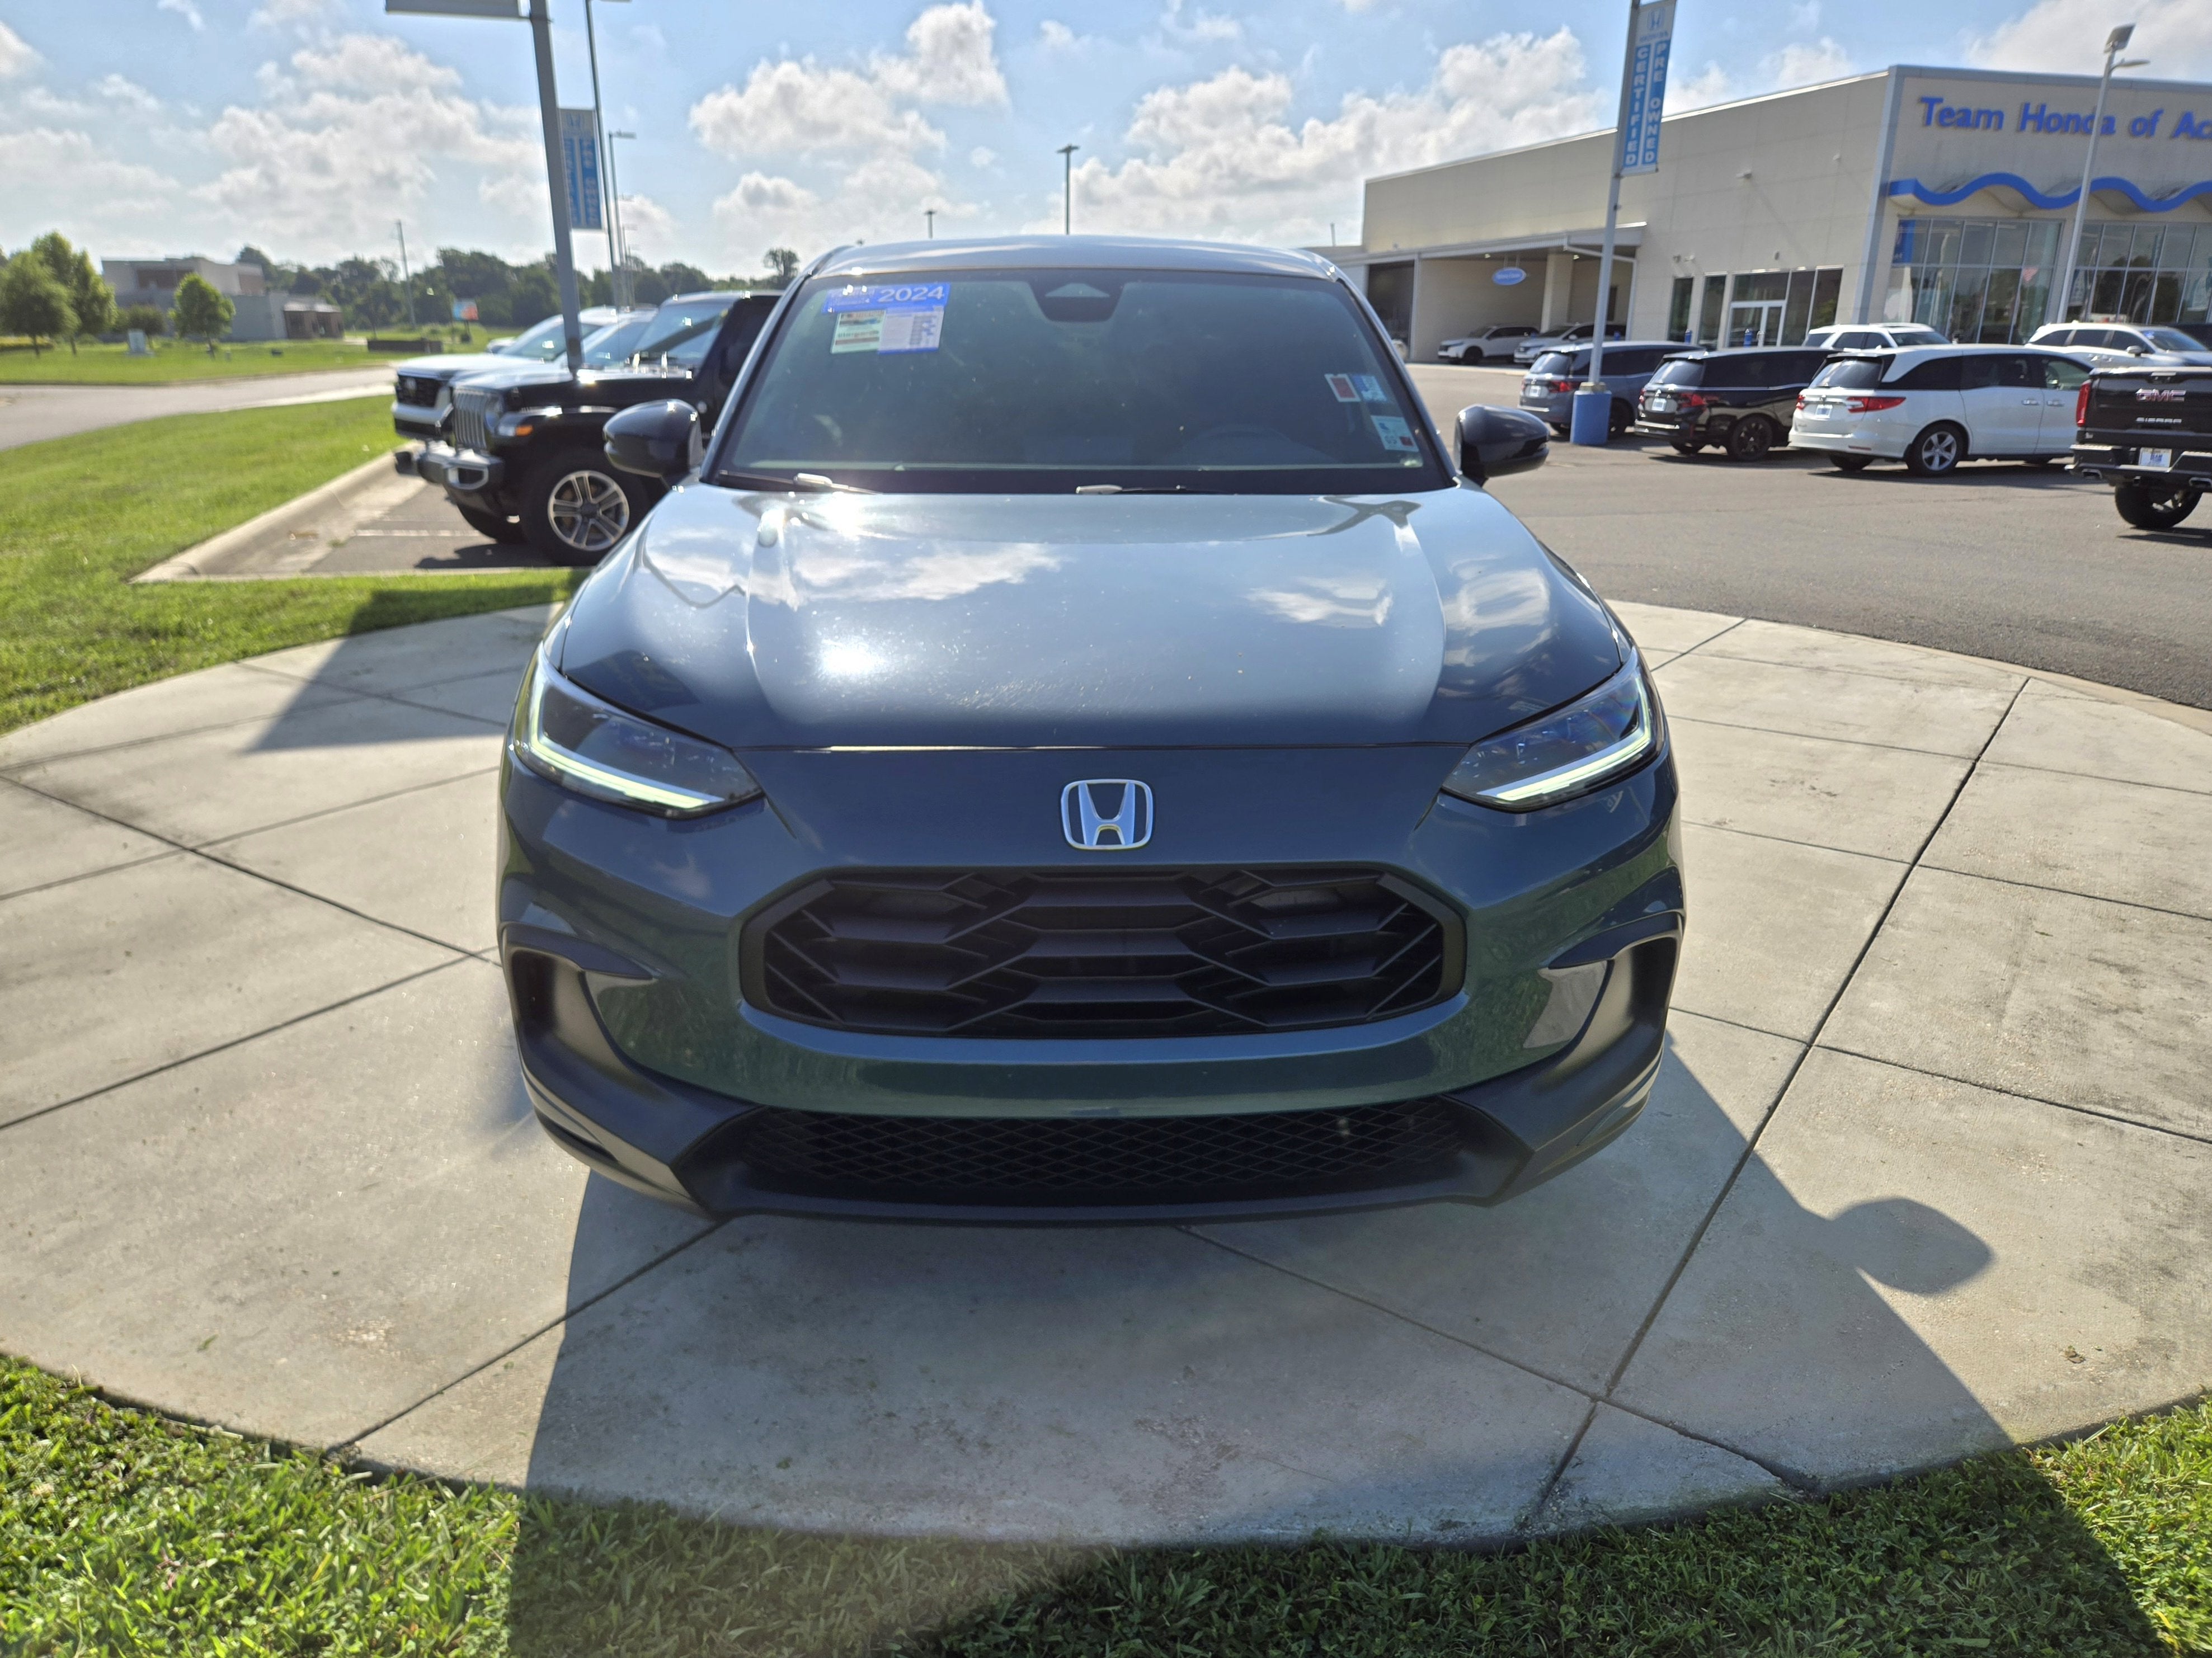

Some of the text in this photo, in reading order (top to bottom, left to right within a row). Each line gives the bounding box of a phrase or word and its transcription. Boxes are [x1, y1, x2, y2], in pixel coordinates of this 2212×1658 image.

[1625, 47, 1649, 165] CERTIFIED
[1644, 43, 1668, 163] PRE OWNED
[1920, 96, 2004, 131] Team
[2019, 102, 2116, 135] Honda
[2130, 109, 2164, 137] of
[877, 286, 945, 303] 2024
[2135, 388, 2186, 402] GMC
